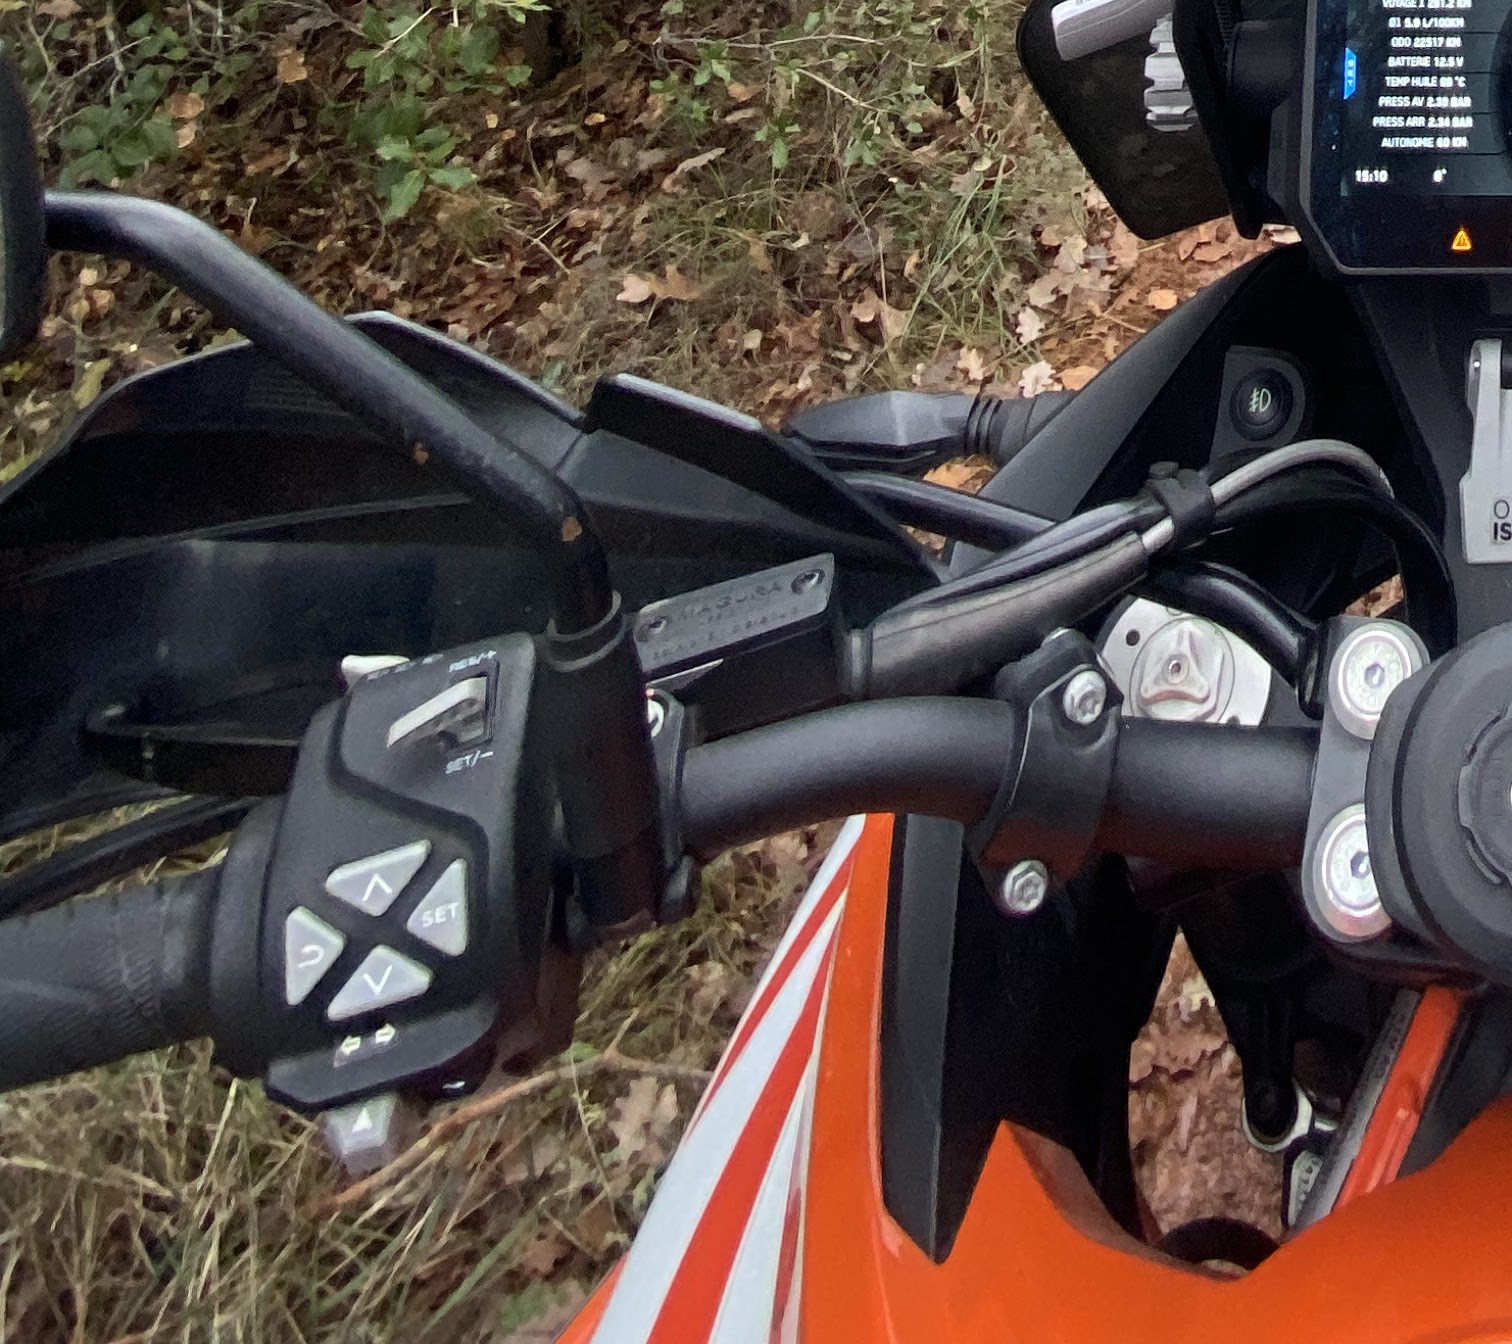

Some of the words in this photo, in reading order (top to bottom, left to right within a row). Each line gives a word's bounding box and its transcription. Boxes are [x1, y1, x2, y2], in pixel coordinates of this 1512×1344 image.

[1391, 36, 1411, 48] ODO
[1413, 36, 1445, 48] 22517
[1445, 36, 1462, 48] KM
[1388, 56, 1431, 67] BATTERIE
[1456, 56, 1464, 67] V
[1385, 76, 1411, 87] TEMP
[1411, 76, 1438, 87] HUILE
[1378, 96, 1411, 107] PRESS
[1411, 96, 1425, 107] AV
[1450, 96, 1472, 108] BAR
[1372, 116, 1405, 128] PRESS
[1405, 116, 1426, 128] ARR
[1451, 116, 1473, 128] BAR
[1381, 136, 1434, 148] AUTONOMIE
[1451, 136, 1469, 148] KM
[1355, 169, 1388, 183] 15:10
[1493, 522, 1512, 541] IS
[421, 901, 461, 928] SET
